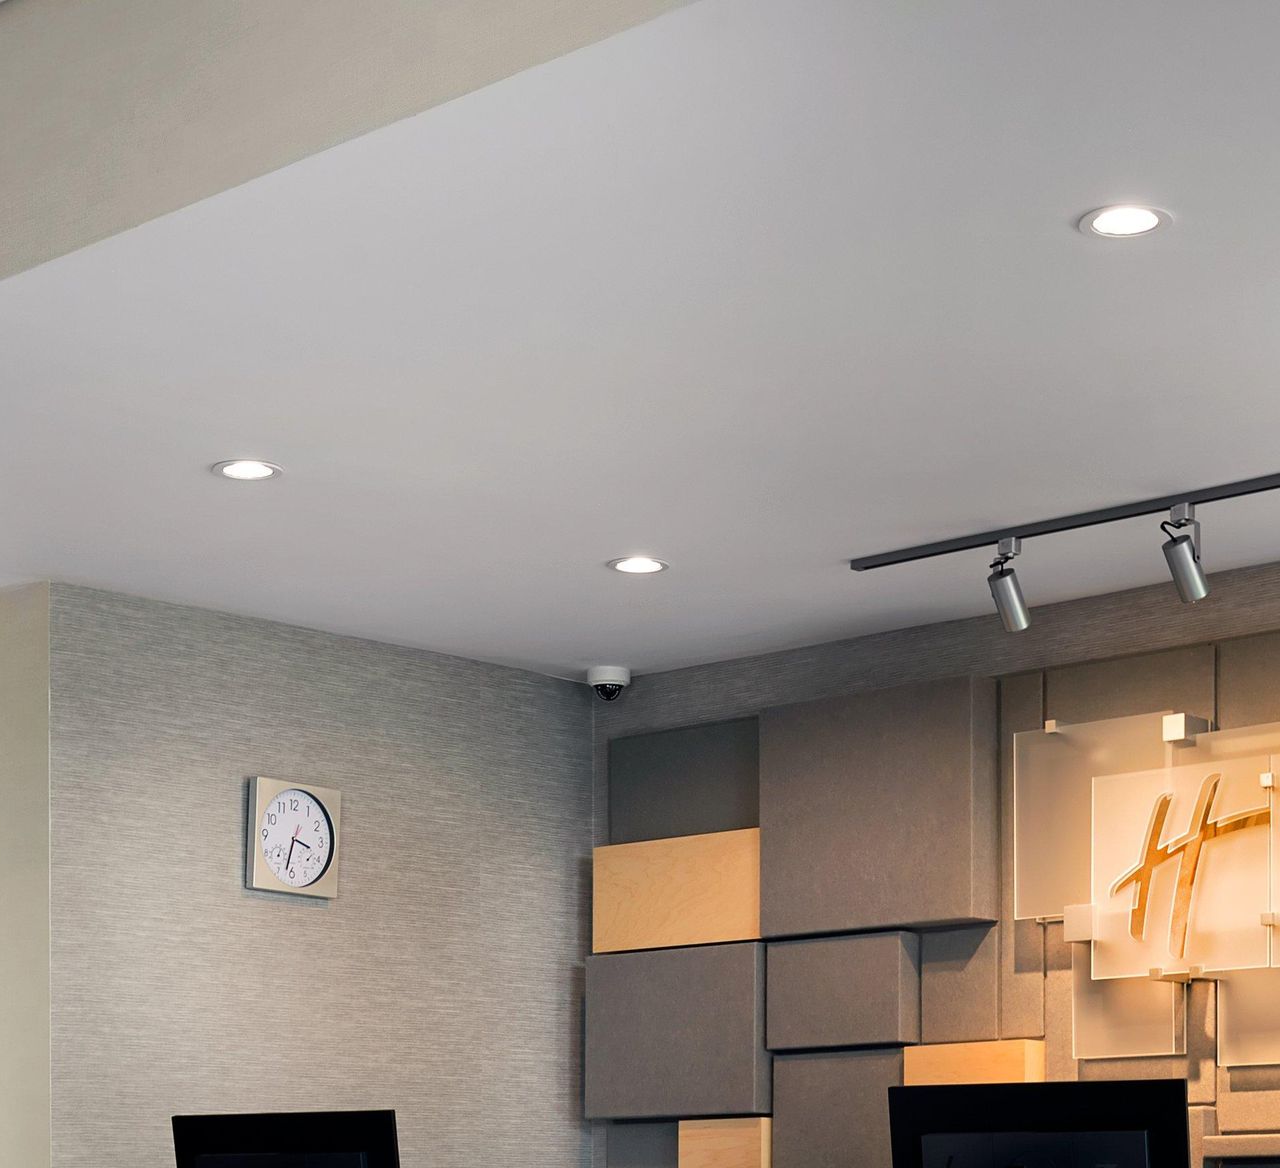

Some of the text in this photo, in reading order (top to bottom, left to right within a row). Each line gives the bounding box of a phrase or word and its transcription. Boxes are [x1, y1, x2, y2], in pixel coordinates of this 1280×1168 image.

[277, 801, 286, 814] 11
[289, 799, 299, 812] 12
[267, 812, 277, 826] 10
[314, 821, 320, 832] 2
[262, 829, 268, 841] 9
[318, 837, 324, 849] 3
[289, 867, 295, 879] 6
